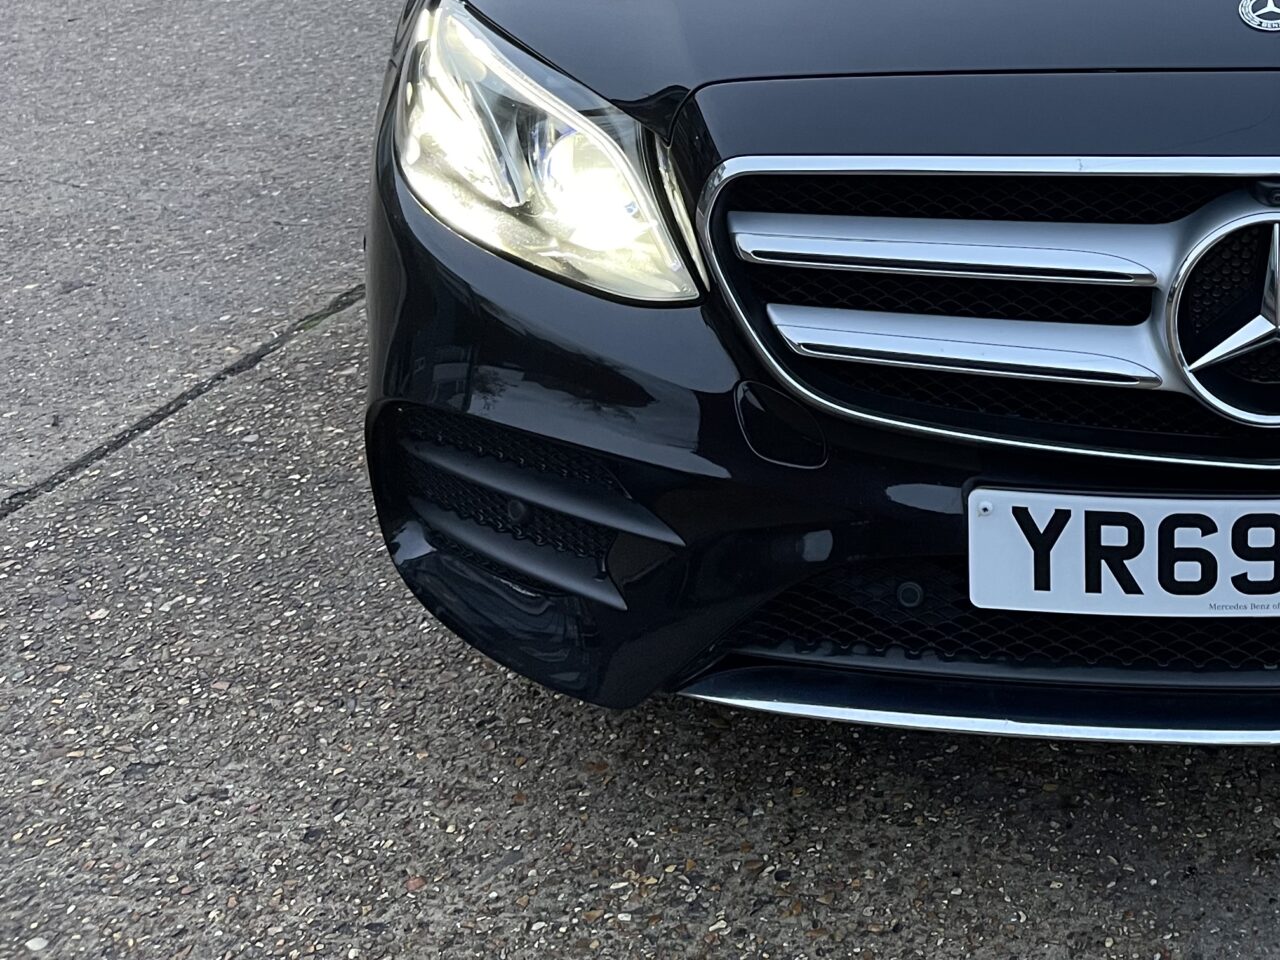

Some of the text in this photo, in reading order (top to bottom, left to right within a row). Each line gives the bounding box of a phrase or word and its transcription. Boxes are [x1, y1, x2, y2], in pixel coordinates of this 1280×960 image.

[1208, 602, 1248, 611] Mercedes
[1250, 602, 1270, 610] Benz
[1272, 601, 1280, 610] of
